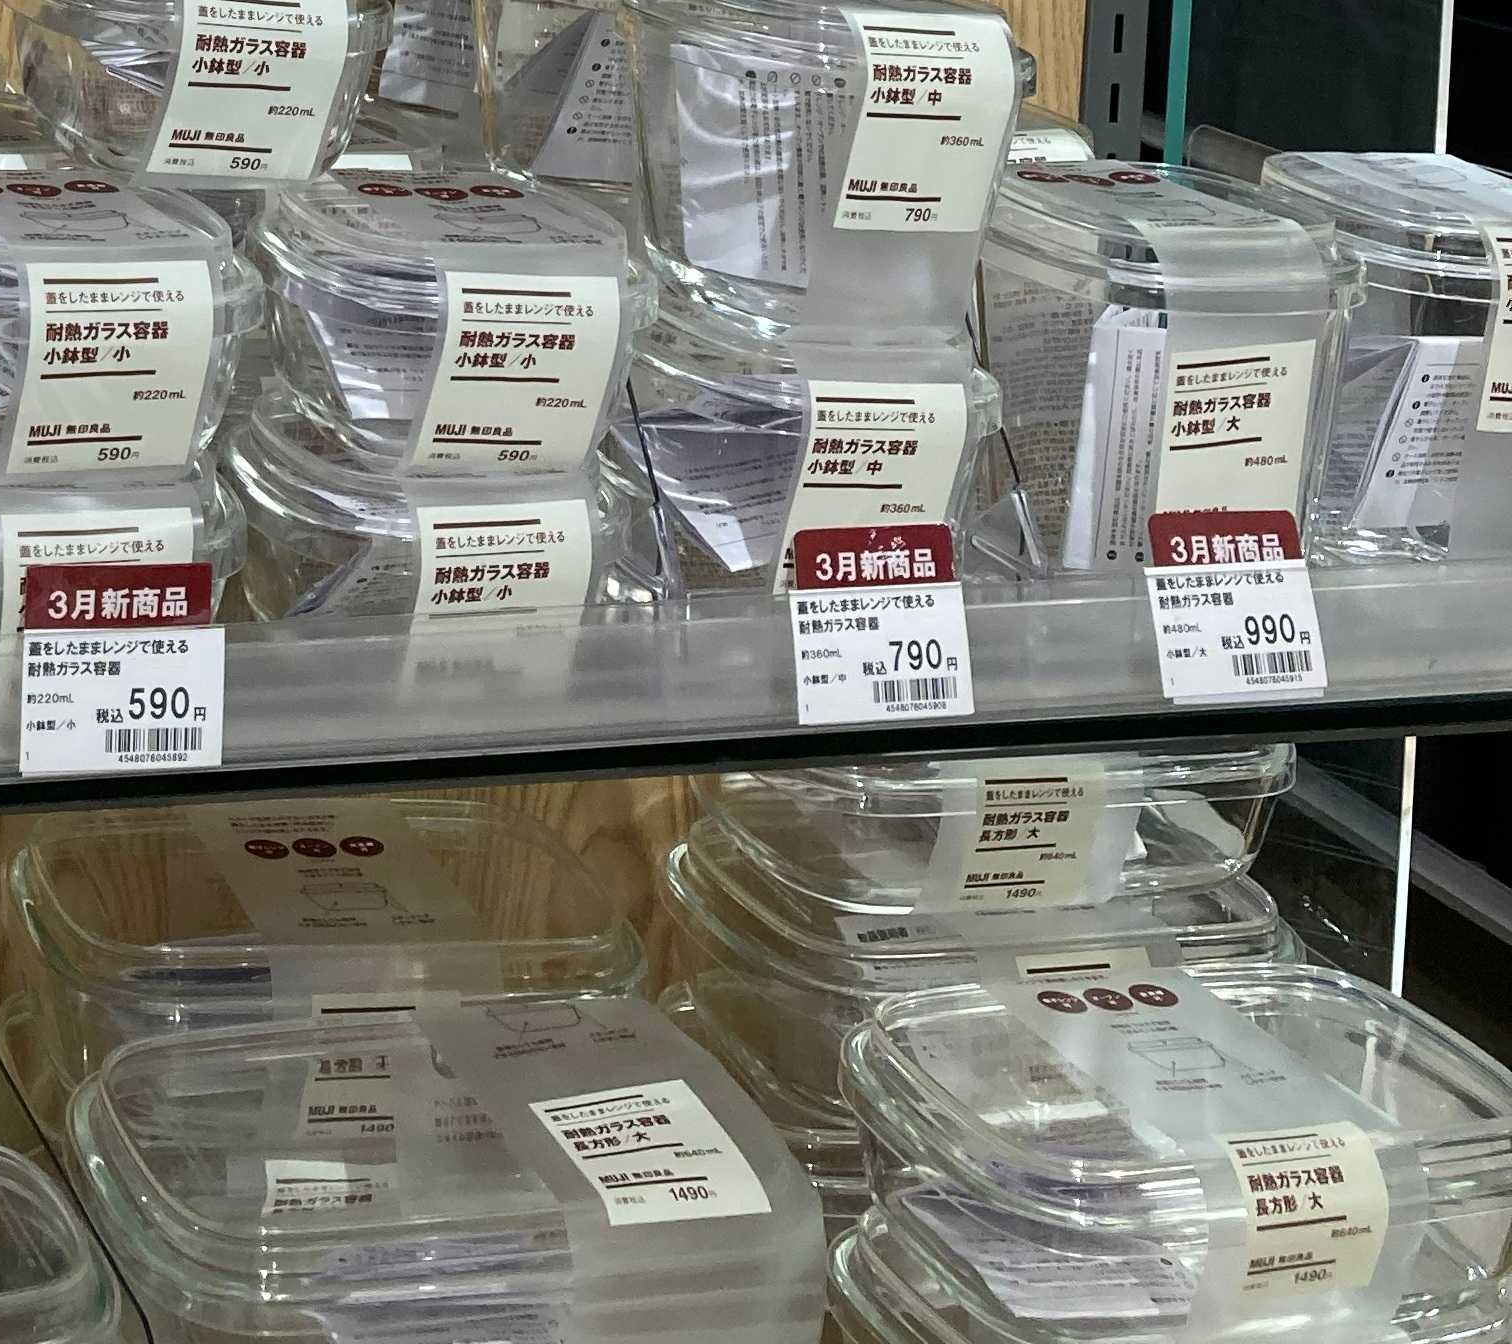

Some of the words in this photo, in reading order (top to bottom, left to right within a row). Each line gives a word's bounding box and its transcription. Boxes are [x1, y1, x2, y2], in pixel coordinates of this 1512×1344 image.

[195, 33, 308, 59] 耐熱ガラス容器
[872, 63, 973, 86] 耐熱ガラス容器
[171, 129, 202, 143] MUJI
[204, 131, 245, 144] 無印良品
[848, 178, 877, 193] MUJI
[880, 180, 918, 194] 無印良品
[45, 320, 169, 342] 耐熱ガラス容器
[458, 330, 576, 351] 耐熱ガラス容器
[1172, 392, 1272, 416] 耐熱ガラス容器
[28, 424, 62, 438] MUJI
[66, 422, 111, 435] 無印良品
[434, 423, 467, 436] MUJI
[470, 424, 513, 437] 無印良品
[812, 437, 919, 457] 耐熱ガラス容器
[1170, 533, 1285, 563] 3月新商品
[434, 561, 551, 585] 耐熱ガラス容器
[815, 548, 936, 581] 3月新商品
[48, 586, 188, 620] 3月新商品
[1159, 593, 1234, 609] 耐熱ガラス容器
[799, 617, 880, 634] 耐熱ガラス容器
[28, 639, 189, 657] 蓋をしたままレンジで使える
[28, 660, 121, 677] 耐熱ガラス容器
[982, 810, 1070, 826] 耐熱ガラス容器
[561, 1114, 672, 1140] 耐熱ガラス容器
[598, 1173, 630, 1185] MUJI
[1247, 1165, 1345, 1192] 耐熱ガラス容器
